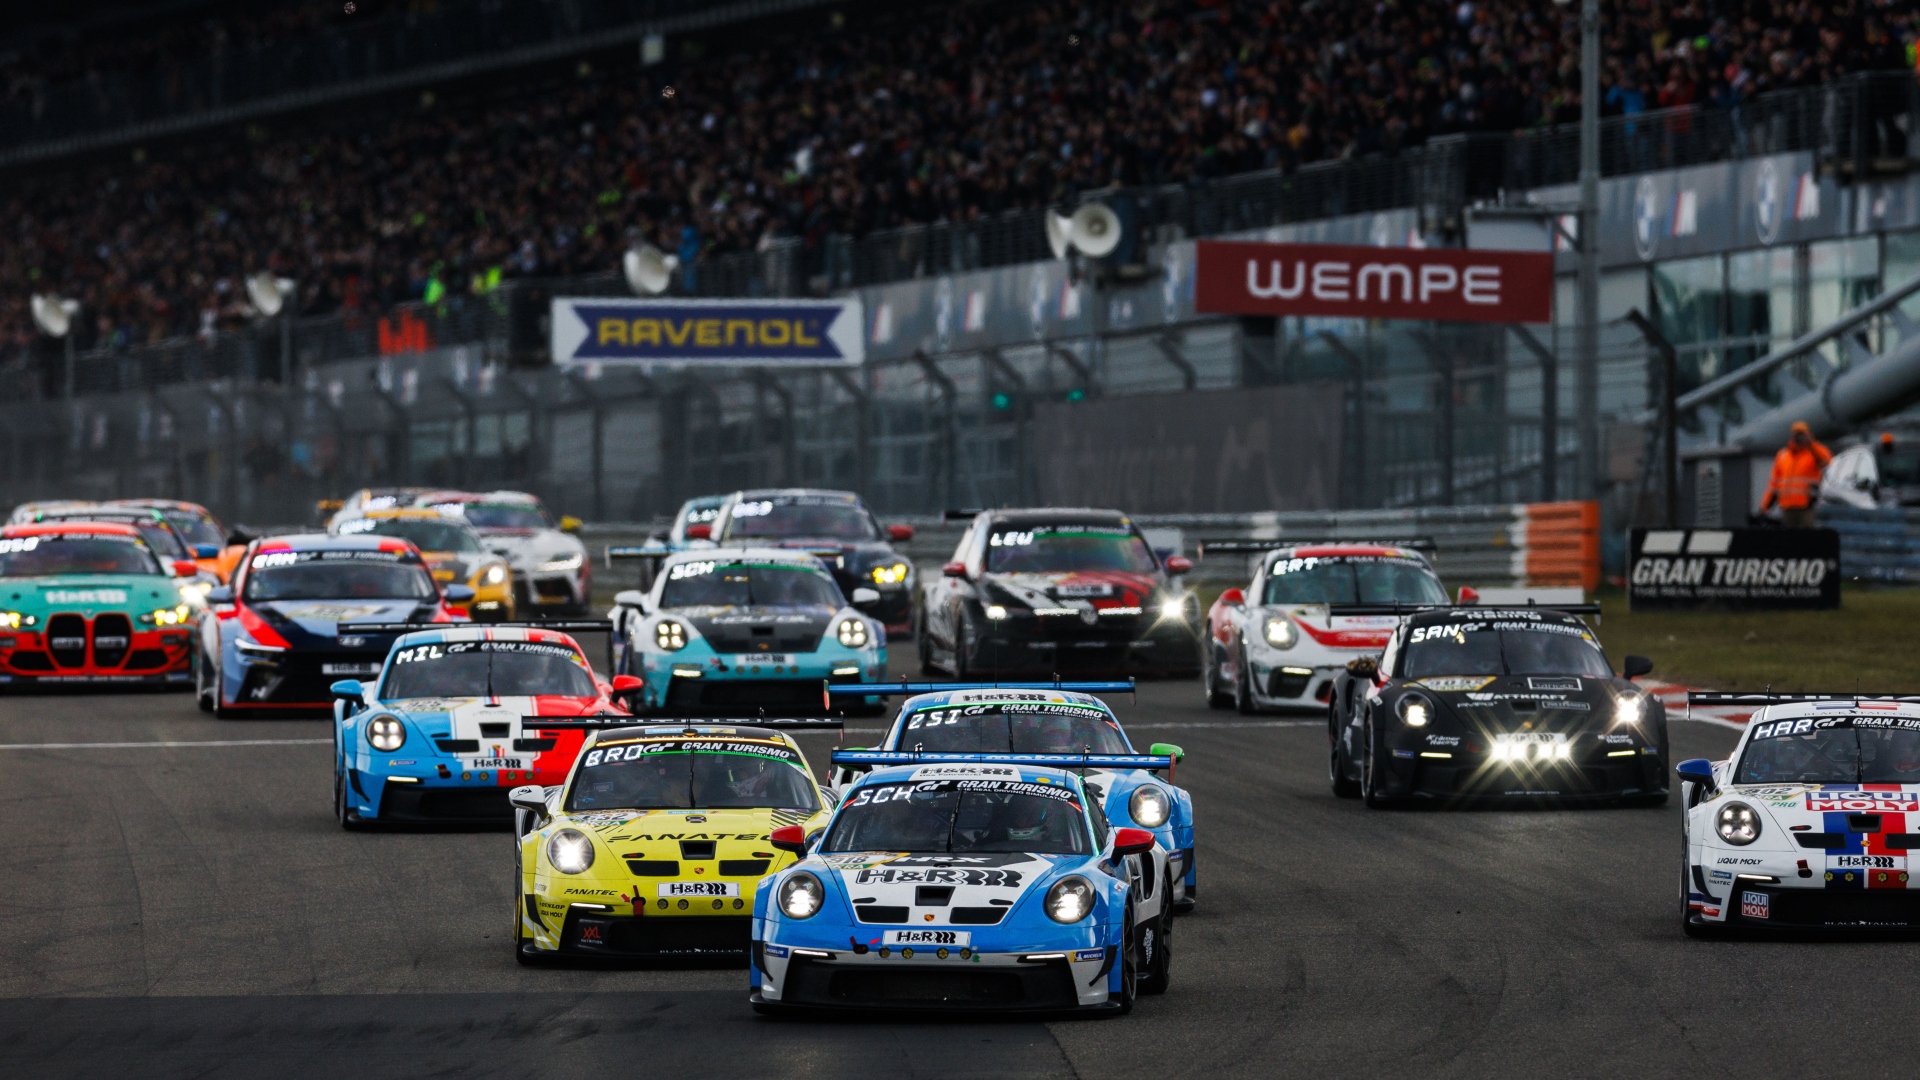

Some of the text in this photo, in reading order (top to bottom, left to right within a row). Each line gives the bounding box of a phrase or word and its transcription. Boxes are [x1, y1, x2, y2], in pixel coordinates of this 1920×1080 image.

[1247, 260, 1501, 304] WEMPE
[597, 318, 820, 346] RAVENOL
[990, 531, 1034, 547] LEU
[670, 561, 715, 580] SCH
[1272, 557, 1319, 575] ERT
[1632, 558, 1827, 586] GRAN TURISMO
[1410, 624, 1461, 643] SAN
[1493, 622, 1527, 630] GRAN
[1530, 622, 1583, 636] TURISMO
[397, 646, 443, 665] MIL
[481, 642, 516, 650] GRAN
[519, 643, 573, 657] TURISMO
[1043, 705, 1103, 719] TURISMO
[1755, 719, 1814, 740] HAR
[1852, 717, 1894, 725] GRAN
[585, 745, 643, 768] BRO
[681, 742, 723, 750] GRAN
[727, 743, 790, 758] TURISMO
[474, 759, 503, 768] H&R
[920, 766, 982, 775] H&R
[853, 785, 916, 807] SCH
[957, 780, 1001, 789] GRAN
[1003, 781, 1072, 799] TURISMO
[1025, 791, 1069, 803] SIMULATOR
[1812, 792, 1913, 800] LIQUI
[1812, 801, 1918, 810] MOLY
[1717, 857, 1739, 865] LIQUI
[1837, 856, 1872, 868] H&R
[856, 869, 963, 886] H&R
[564, 888, 618, 896] FANATEC
[670, 883, 706, 895] H&R
[1744, 893, 1767, 906] LIQUI
[1743, 904, 1767, 917] MOLY
[583, 926, 601, 940] XXL
[896, 930, 938, 943] H&R
